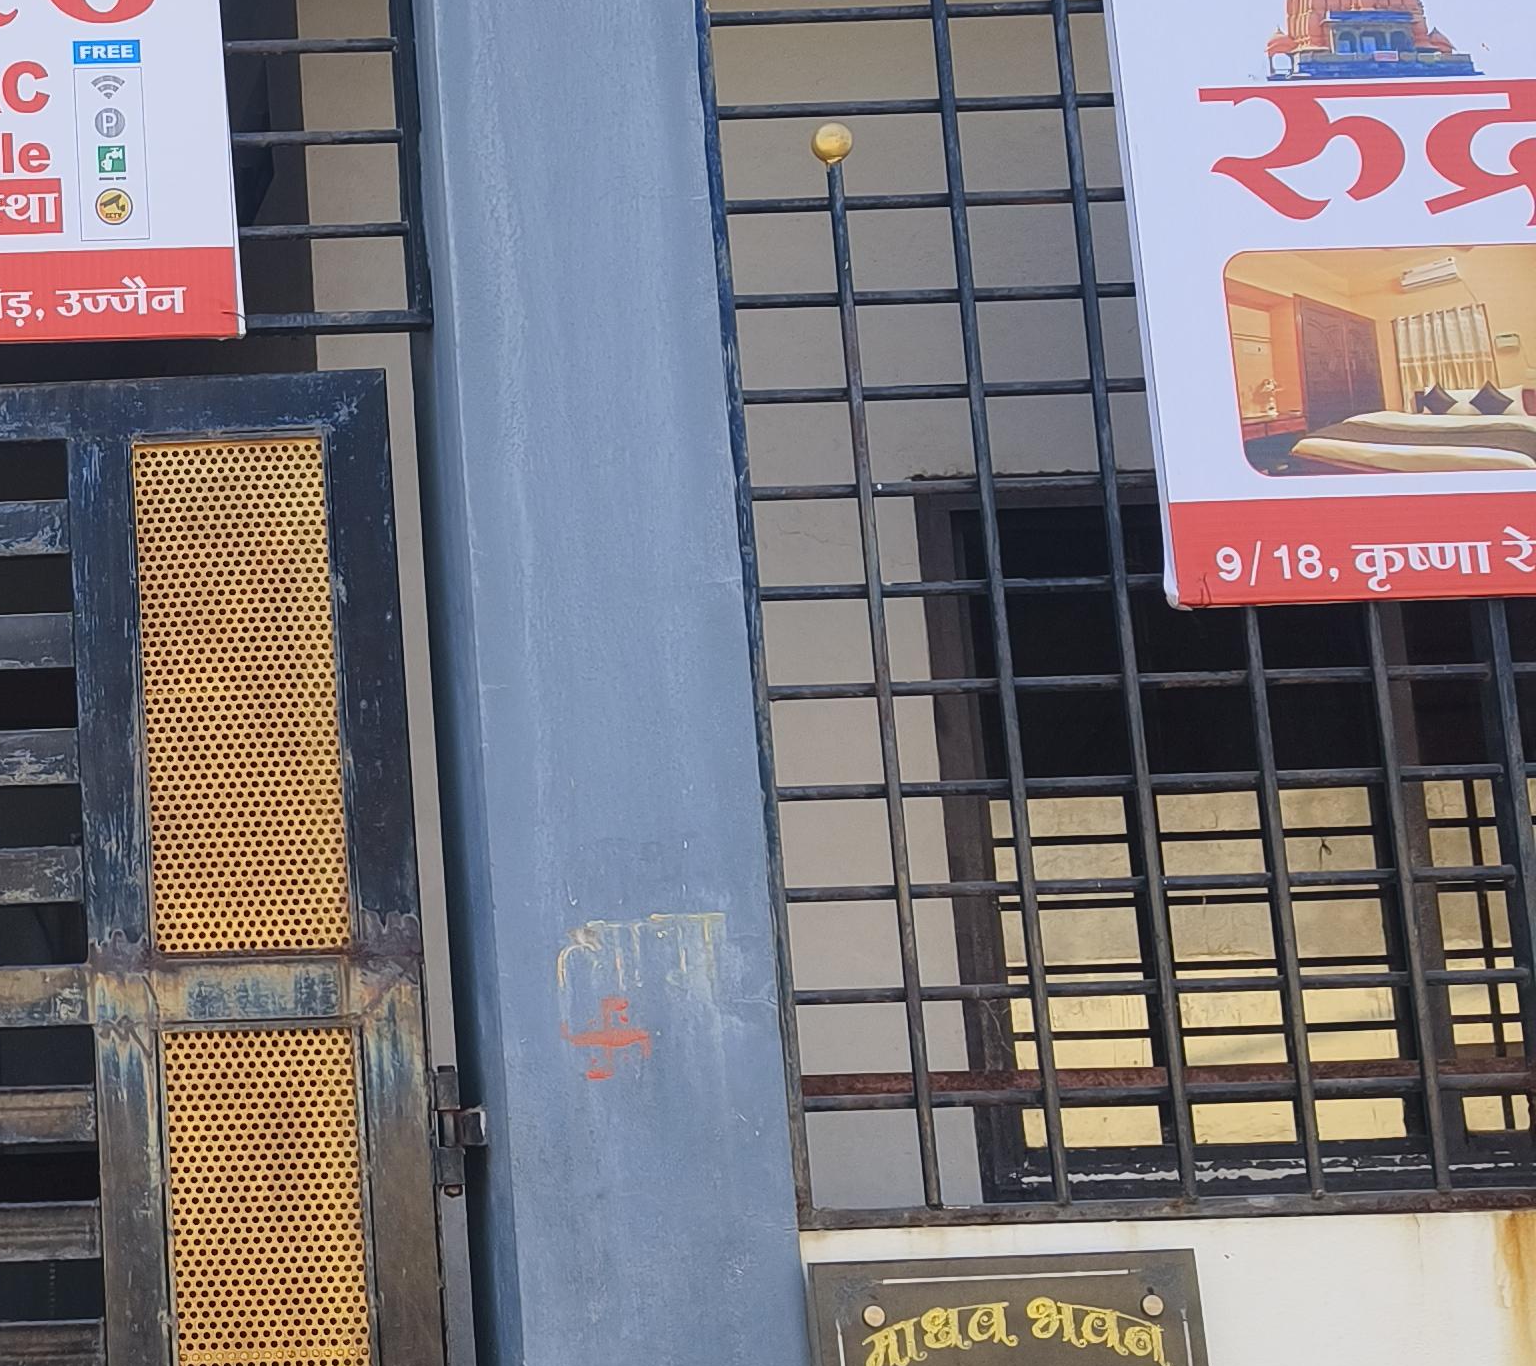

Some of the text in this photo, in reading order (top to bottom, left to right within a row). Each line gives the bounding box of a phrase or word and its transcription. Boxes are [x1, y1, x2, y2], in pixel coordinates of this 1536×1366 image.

[79, 44, 135, 60] FREE
[55, 275, 188, 317] उज्जैन
[1215, 539, 1340, 587] 9/18,
[1350, 540, 1493, 592] कृष्णा
